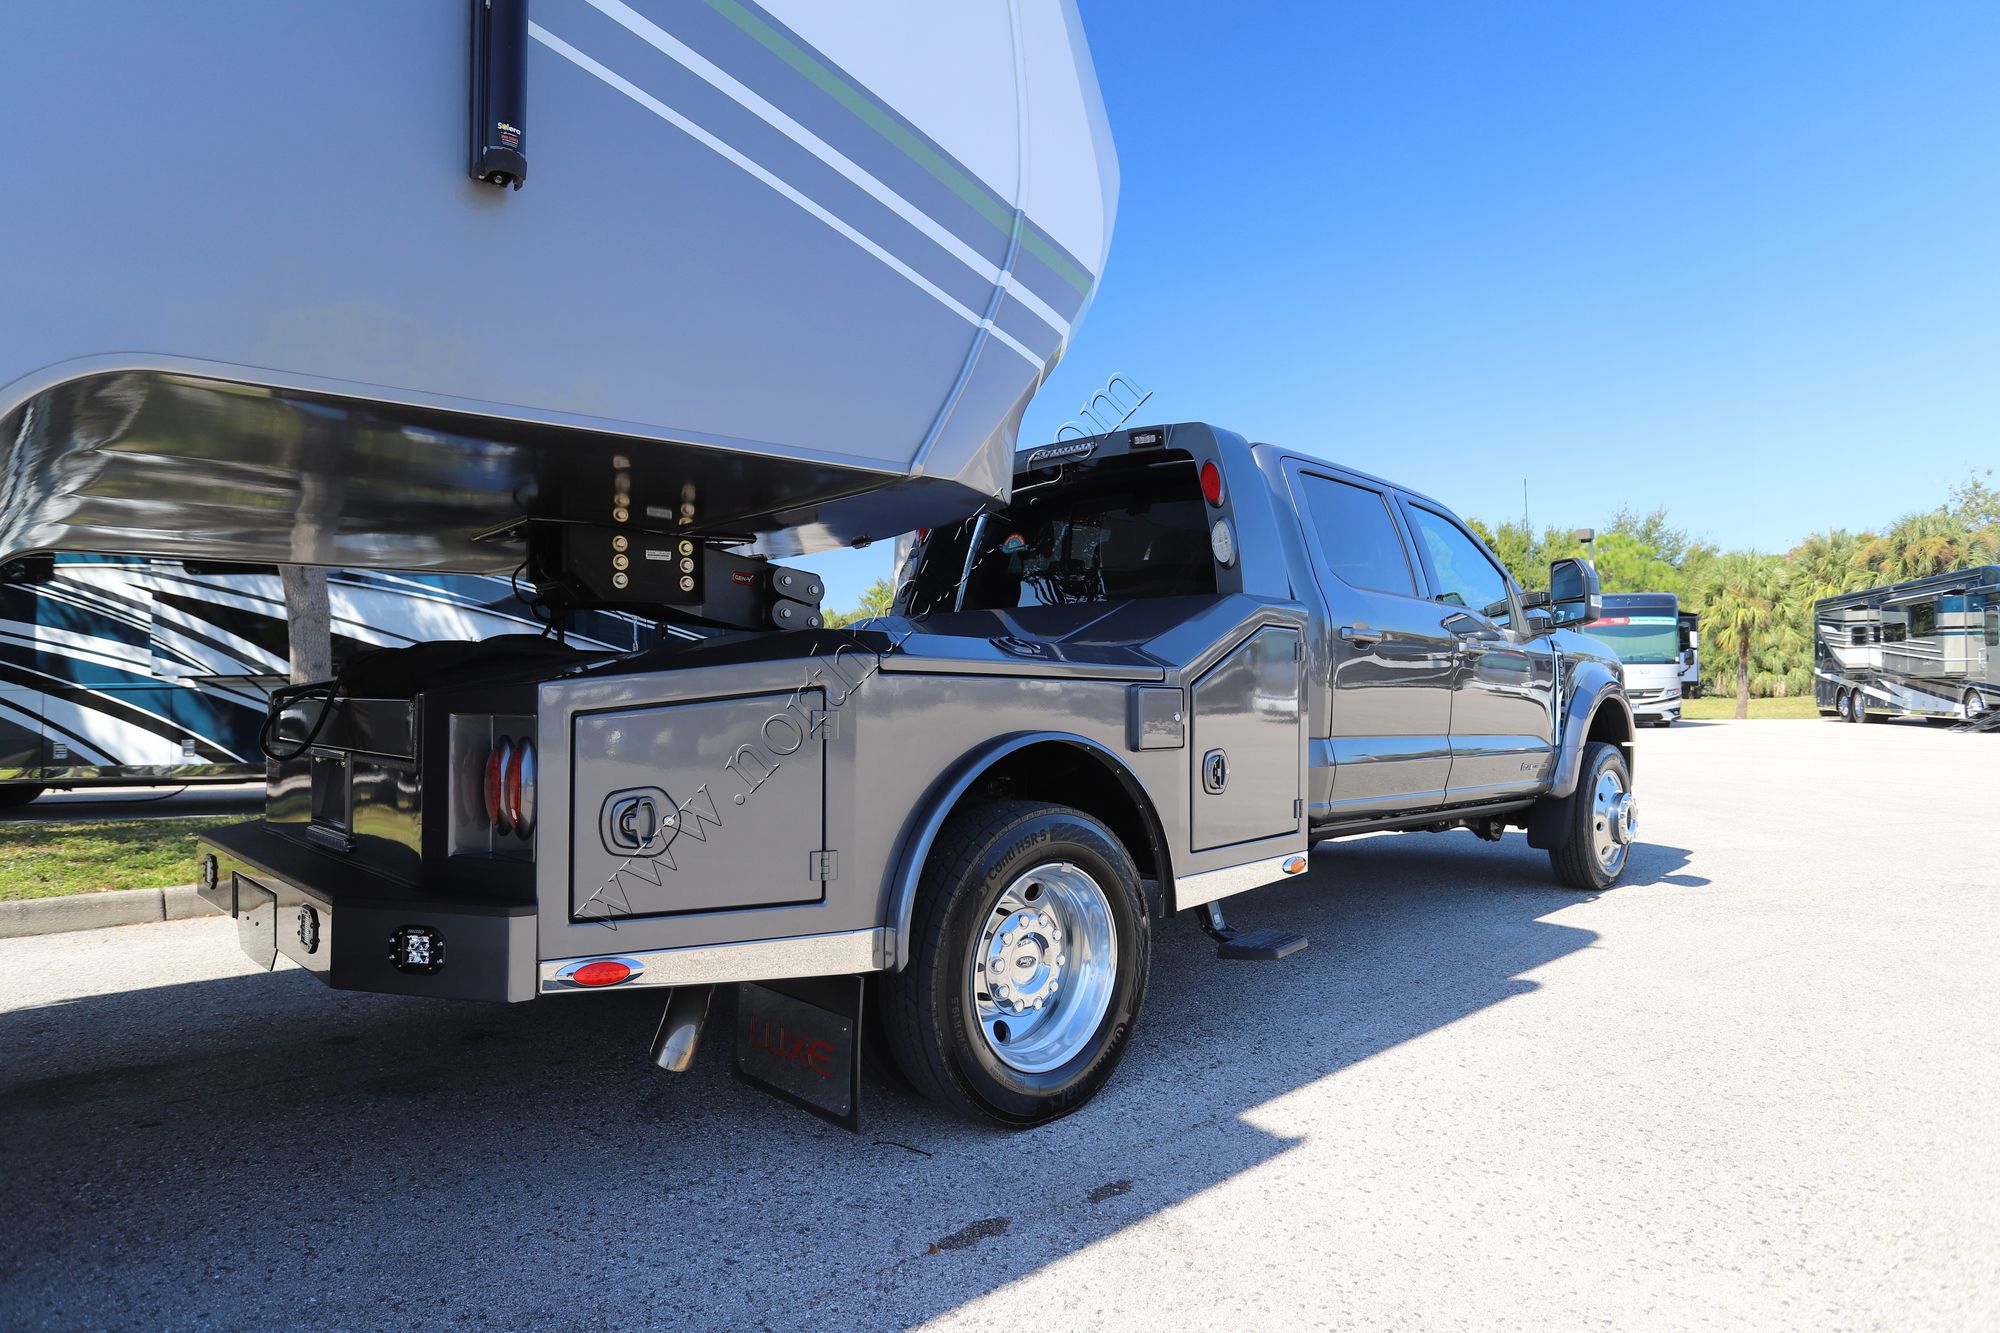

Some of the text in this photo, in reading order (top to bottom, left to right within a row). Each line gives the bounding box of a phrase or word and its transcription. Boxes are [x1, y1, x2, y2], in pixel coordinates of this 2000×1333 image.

[497, 122, 521, 135] Solera
[988, 846, 1016, 880] Conti
[751, 1013, 833, 1081] LUXE
